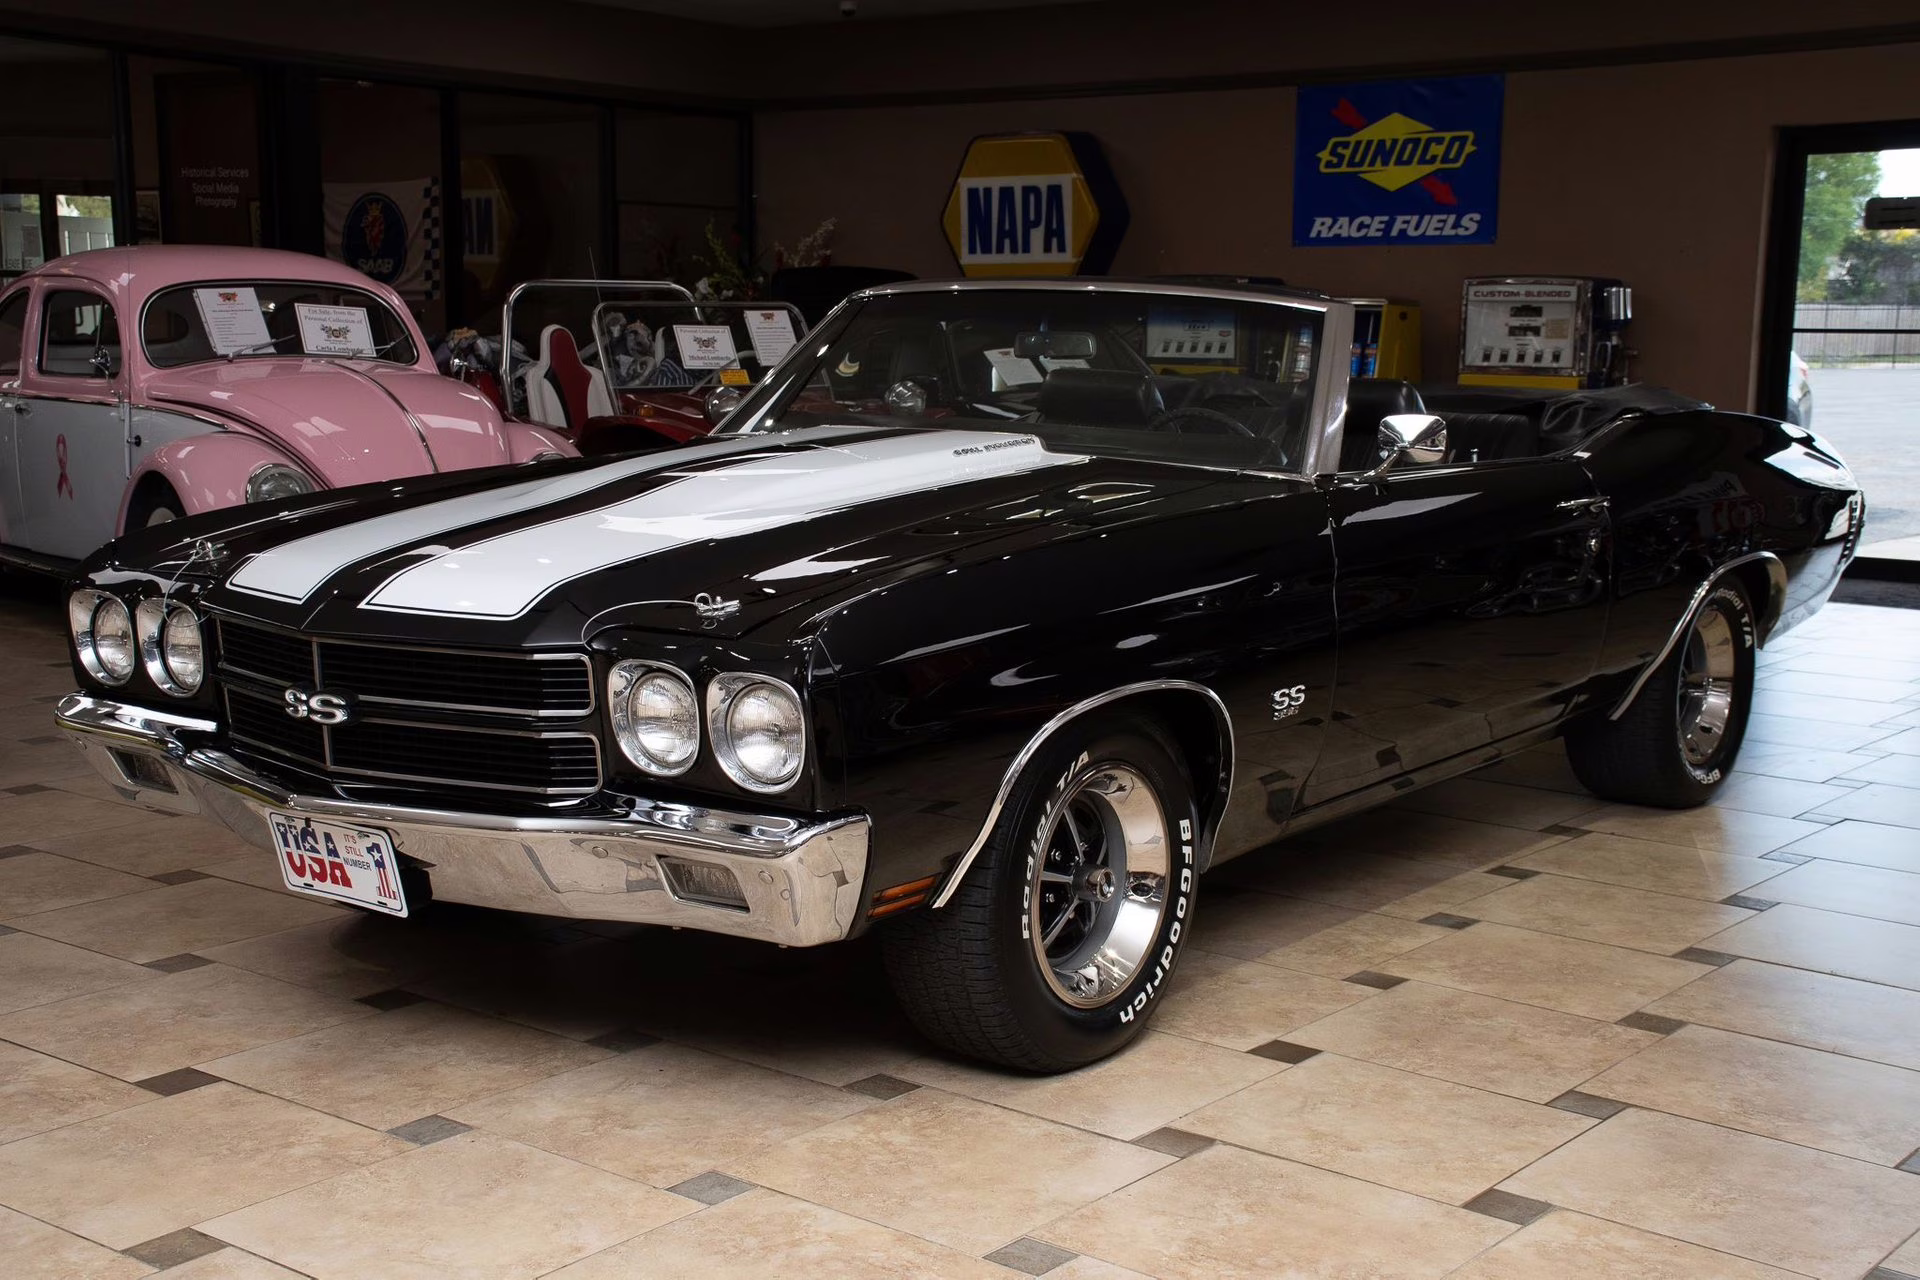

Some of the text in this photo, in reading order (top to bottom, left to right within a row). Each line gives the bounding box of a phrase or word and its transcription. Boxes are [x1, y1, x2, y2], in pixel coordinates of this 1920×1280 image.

[1324, 135, 1469, 168] SUNOCO
[180, 166, 249, 178] Historical Services
[192, 182, 239, 193] Social Media
[195, 196, 237, 208] Photography
[967, 184, 1067, 255] NAPA
[1309, 213, 1481, 238] RACE FUELS
[357, 257, 394, 274] SAAB
[1740, 613, 1753, 648] T/A
[285, 690, 348, 724] SS
[1271, 685, 1306, 709] SS
[1056, 750, 1090, 792] T/A
[343, 833, 356, 844] IT'S
[345, 845, 364, 857] STILL
[275, 822, 353, 888] USA
[343, 857, 372, 871] NUMBER
[366, 842, 399, 901] 1
[1021, 800, 1052, 940] Radial
[1119, 818, 1193, 1025] BFGoodrich
